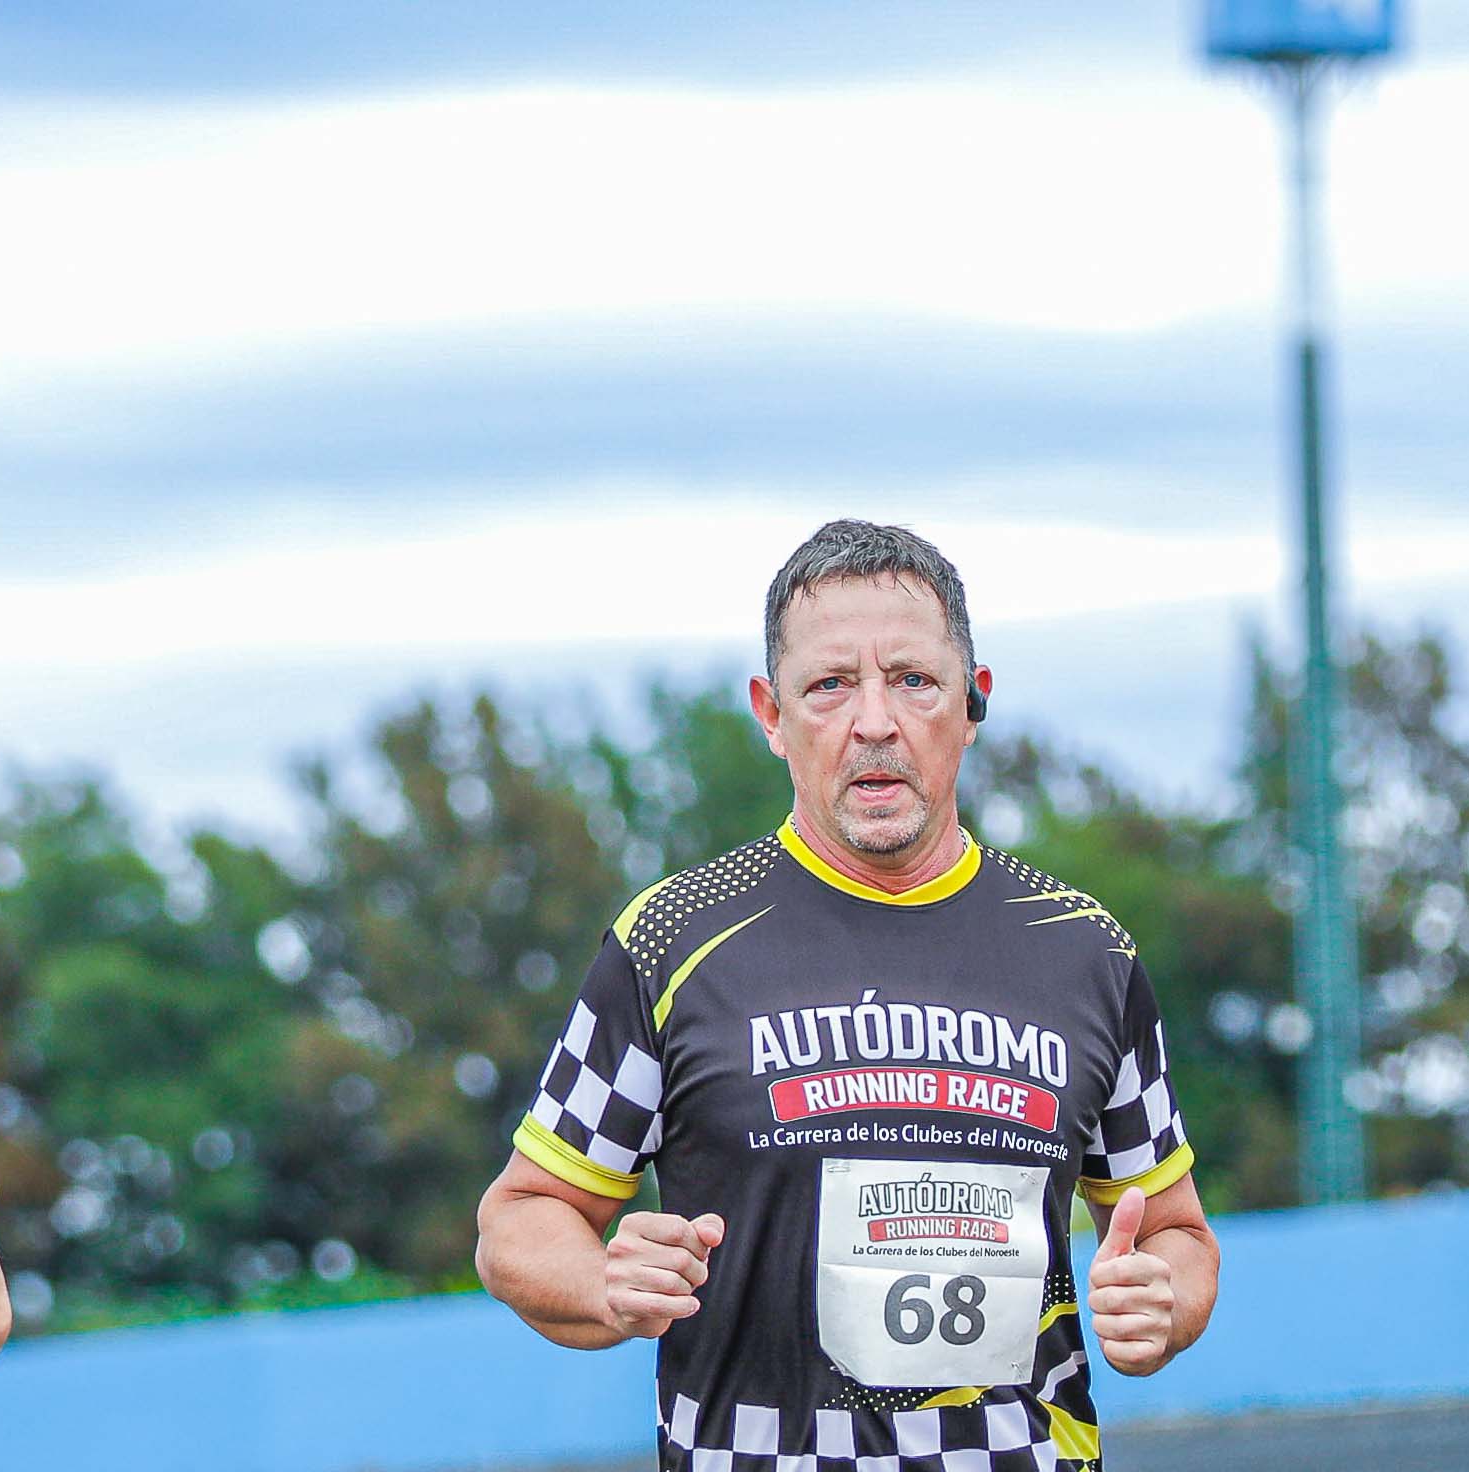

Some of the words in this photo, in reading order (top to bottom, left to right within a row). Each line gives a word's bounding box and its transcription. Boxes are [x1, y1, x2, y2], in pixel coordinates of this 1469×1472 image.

[748, 988, 1068, 1089] AUTÓDROMO
[802, 1072, 938, 1113] RUNNING
[946, 1074, 1030, 1120] RACE
[748, 1131, 770, 1149] La
[773, 1127, 842, 1146] Carrera
[846, 1122, 870, 1142] de
[873, 1122, 898, 1142] los
[902, 1123, 963, 1145] Clubes
[967, 1127, 997, 1147] del
[1001, 1130, 1069, 1161] Noroeste
[858, 1172, 1014, 1220] AUTÓDROMO
[852, 1244, 864, 1255] La
[866, 1245, 903, 1256] Carrera
[906, 1245, 917, 1257] de
[920, 1245, 933, 1257] los
[935, 1246, 968, 1257] Clubes
[969, 1246, 983, 1257] del
[984, 1247, 1020, 1257] Noroeste
[885, 1218, 956, 1239] RUNNING
[960, 1218, 996, 1241] RACE
[884, 1273, 986, 1346] 68
